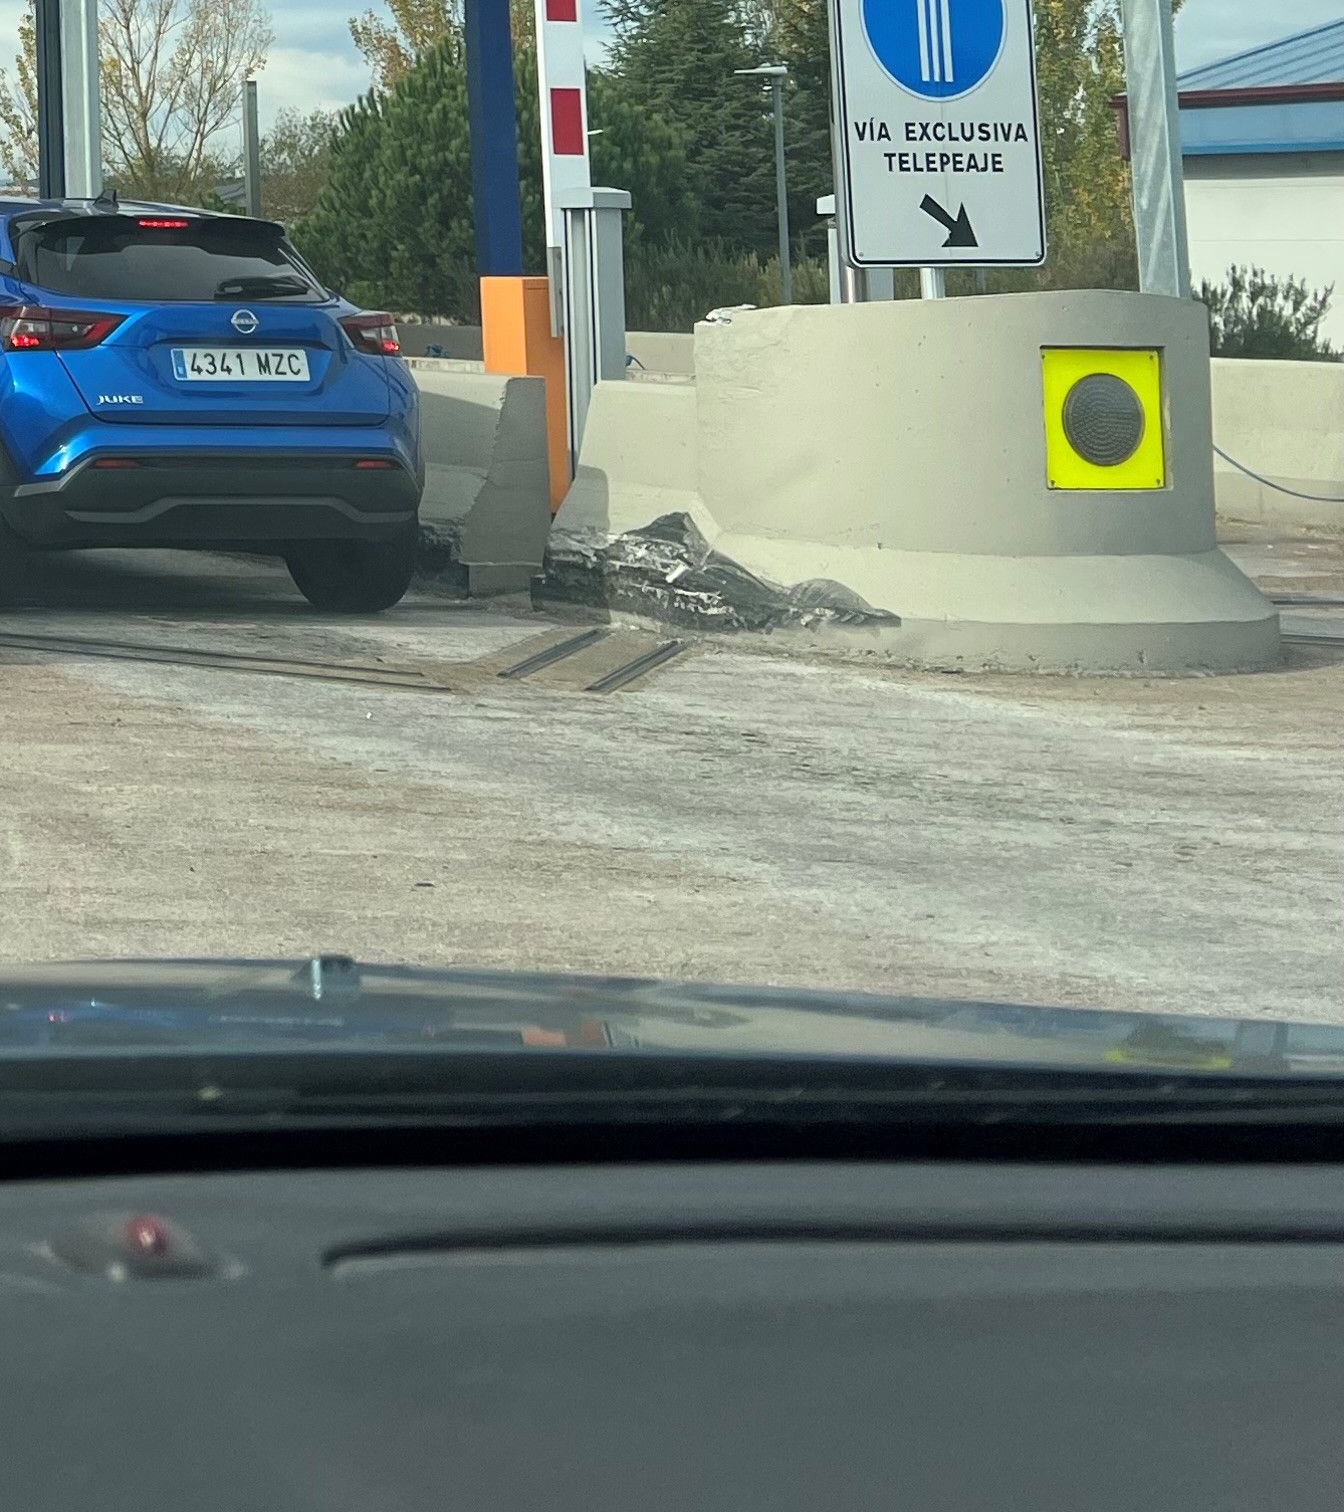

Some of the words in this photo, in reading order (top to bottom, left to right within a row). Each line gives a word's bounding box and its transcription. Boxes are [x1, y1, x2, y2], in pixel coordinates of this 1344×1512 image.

[854, 117, 892, 142] VÍA
[904, 121, 1029, 143] EXCLUSIVA
[883, 152, 1005, 173] TELEPEAJE
[189, 352, 246, 376] 4341
[255, 352, 302, 376] MZC
[96, 395, 144, 406] JUKE
